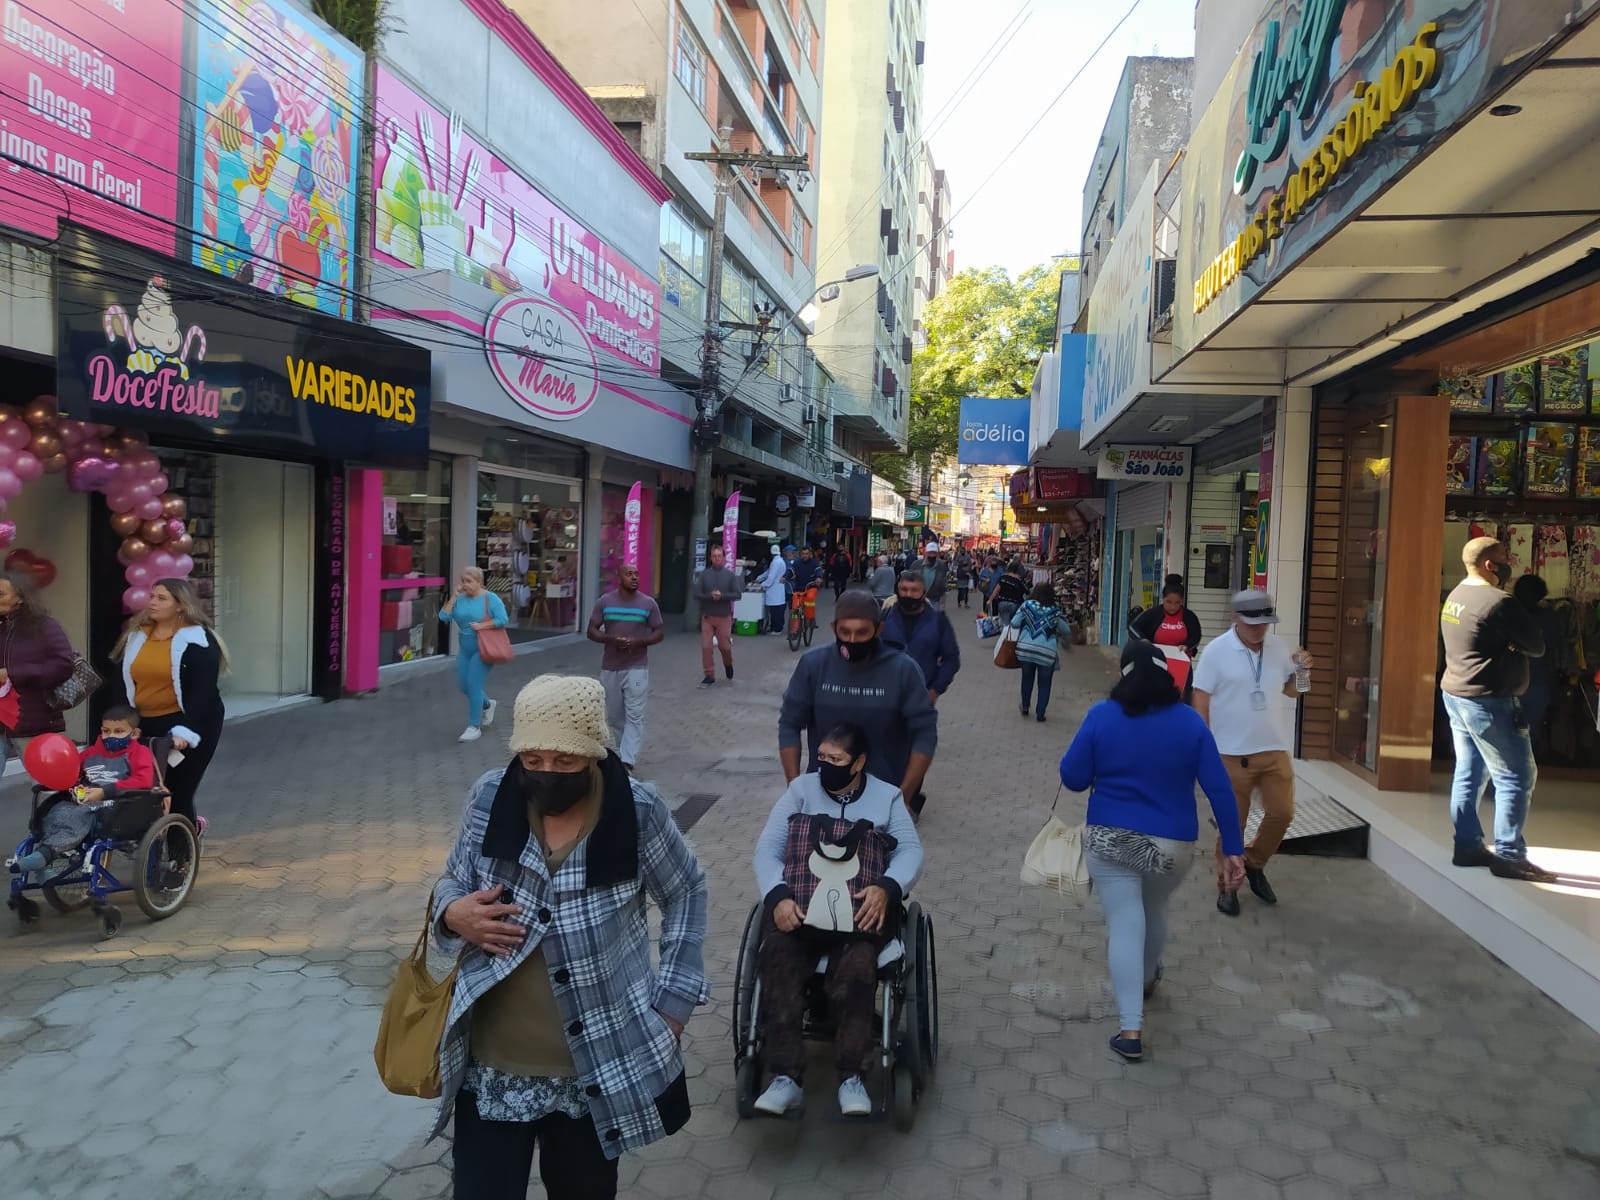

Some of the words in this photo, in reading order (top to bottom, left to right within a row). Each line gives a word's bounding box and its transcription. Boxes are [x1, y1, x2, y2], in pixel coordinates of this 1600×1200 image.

[3, 2, 116, 96] Decoração
[28, 72, 93, 140] Doces
[1267, 193, 1284, 240] E
[1284, 22, 1442, 225] ACESSÓRIOS
[54, 152, 86, 191] em
[91, 160, 142, 212] Geral
[549, 216, 656, 331] UTILIDADES
[521, 307, 564, 352] CASA
[88, 354, 221, 419] DoceFesta
[285, 354, 417, 425] VARIEDADES
[516, 344, 577, 406] Maria
[963, 423, 1025, 442] adélia
[1129, 449, 1185, 461] FARMÁCIAS
[1125, 460, 1150, 475] São
[1152, 461, 1184, 476] João
